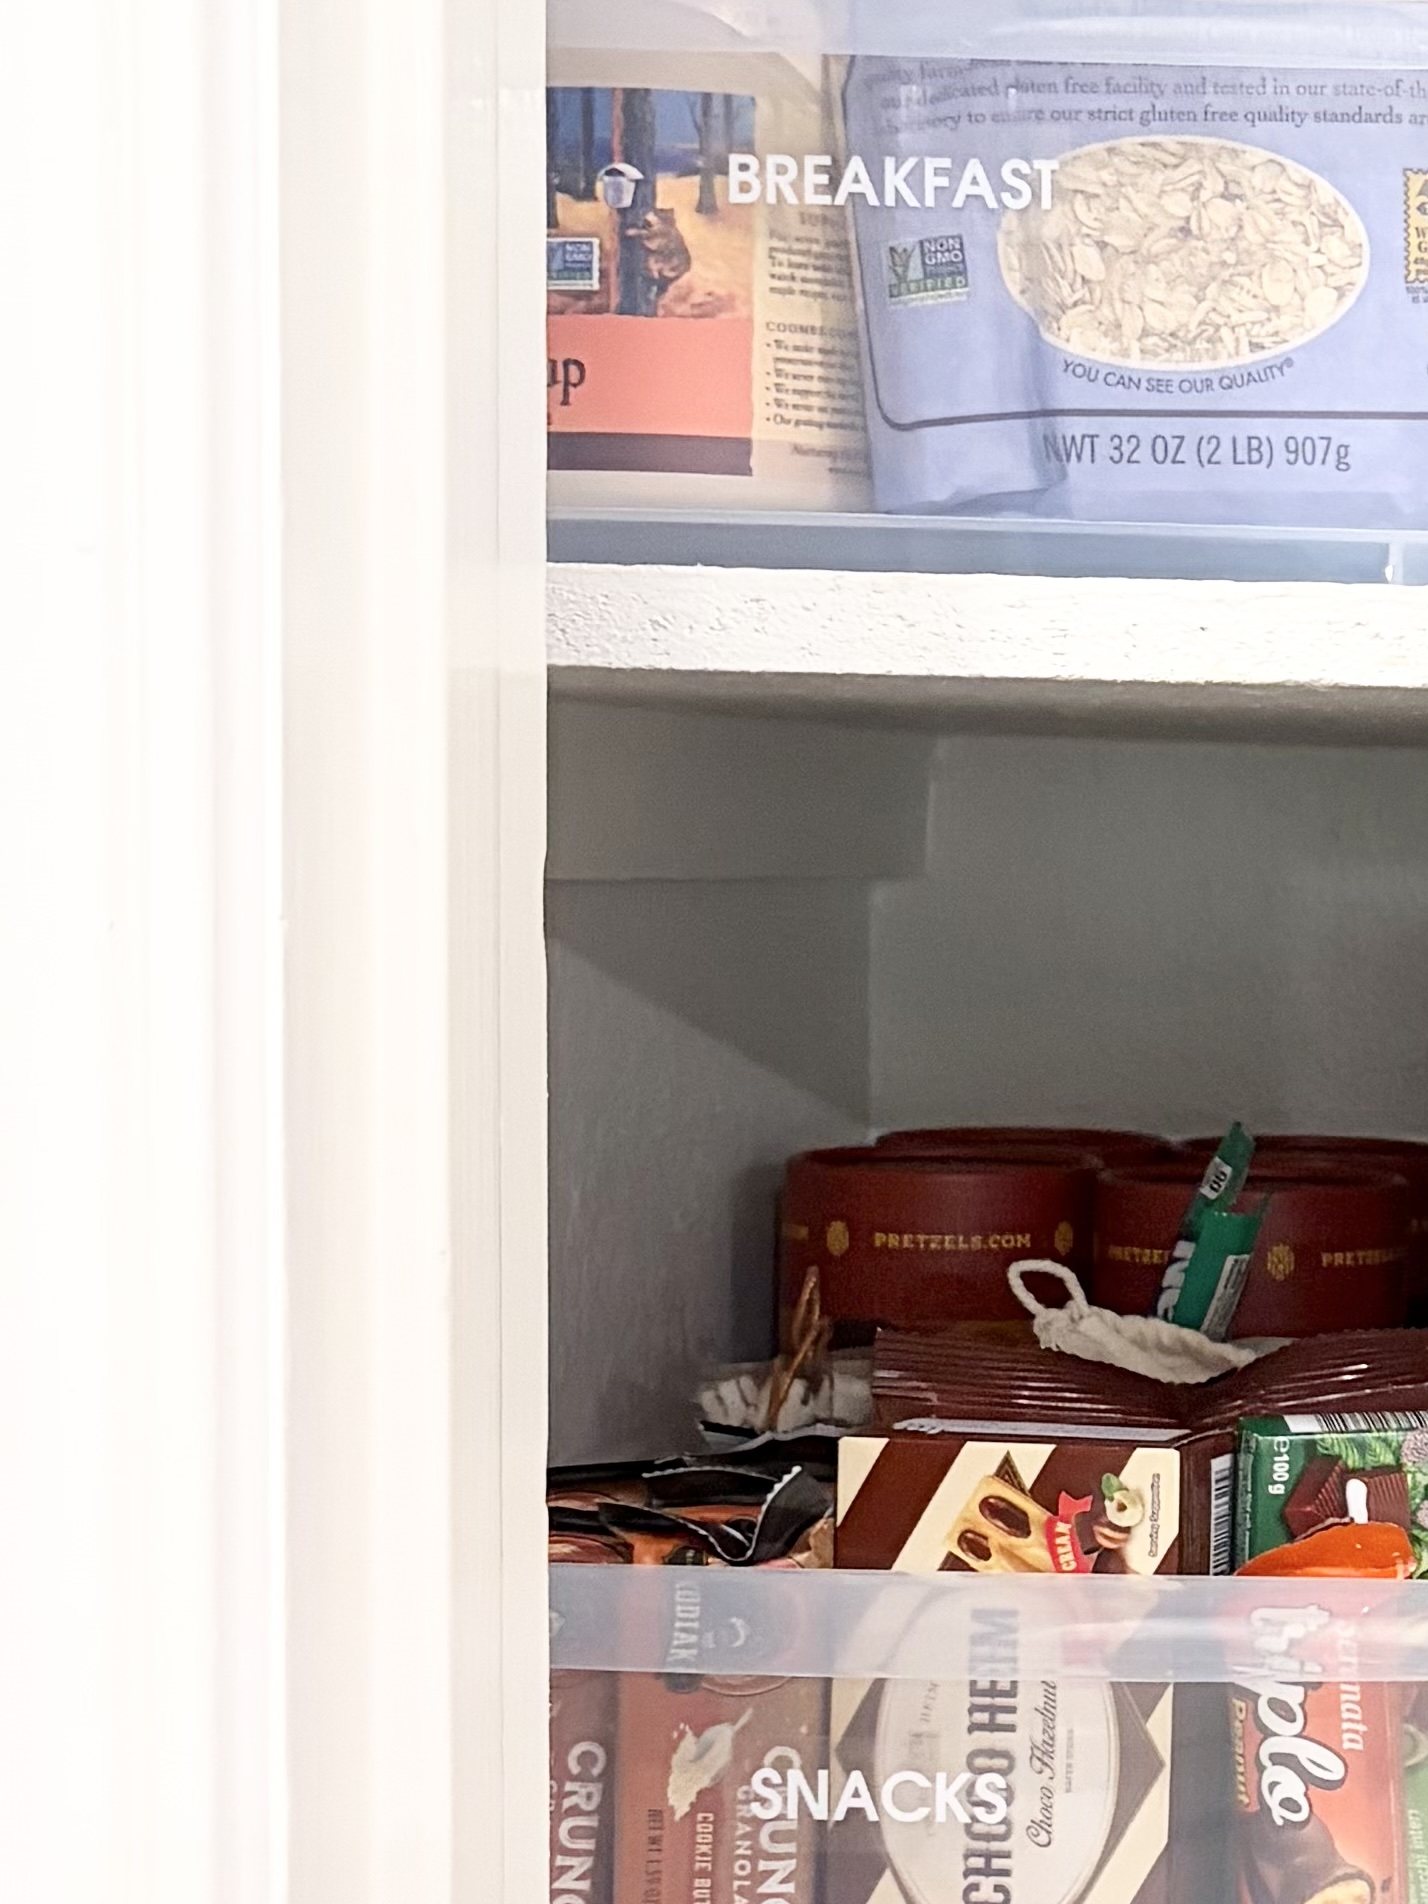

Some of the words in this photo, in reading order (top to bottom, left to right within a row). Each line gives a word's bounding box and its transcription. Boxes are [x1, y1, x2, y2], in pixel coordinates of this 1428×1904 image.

[728, 154, 1059, 210] BREAKFAST
[1063, 359, 1099, 383] YOU
[1104, 371, 1141, 392] CAN
[1146, 376, 1174, 393] SEE
[1179, 376, 1214, 394] OUR
[1219, 363, 1285, 391] QUALITY
[1044, 435, 1101, 465] NWT
[1109, 436, 1140, 464] 32
[1152, 436, 1186, 464] OZ
[1197, 436, 1222, 466] (2
[1232, 436, 1274, 466] LB)
[1285, 437, 1351, 471] 907g
[874, 1232, 1031, 1252] PRETZELS.COM
[750, 1769, 1009, 1825] SNACKS
